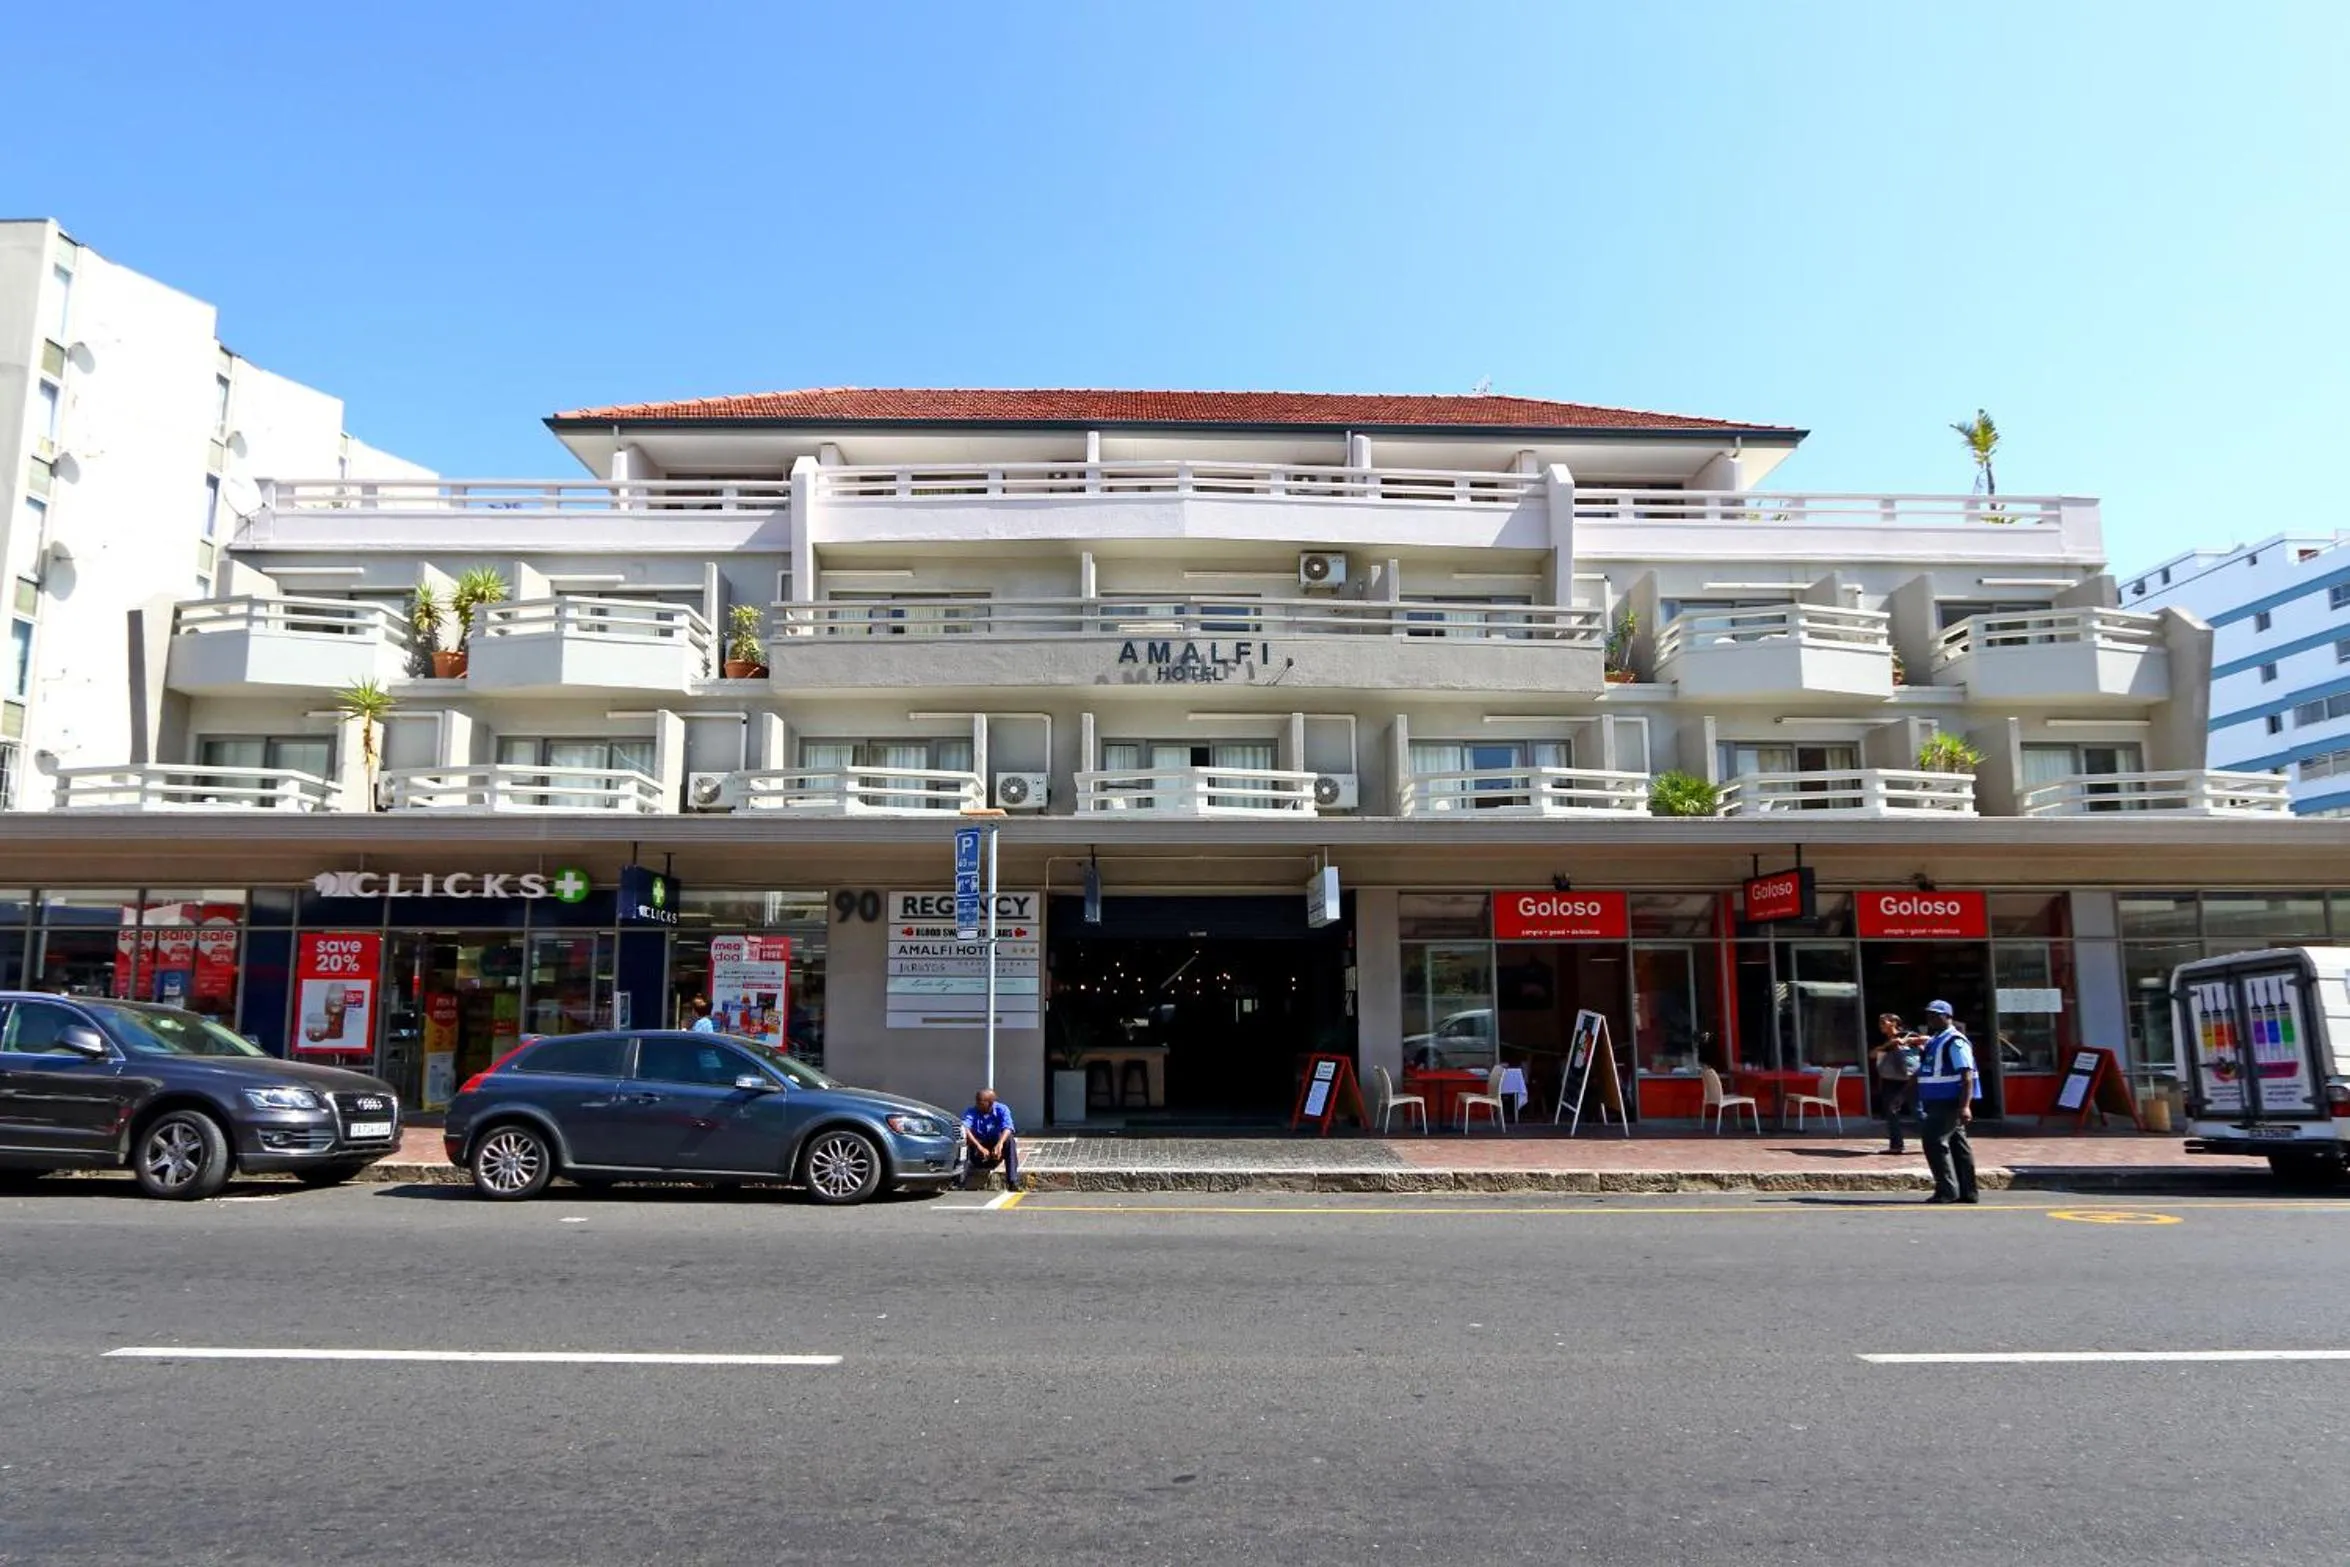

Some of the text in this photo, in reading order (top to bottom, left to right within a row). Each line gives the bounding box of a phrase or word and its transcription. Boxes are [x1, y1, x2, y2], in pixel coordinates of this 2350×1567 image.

[1119, 641, 1268, 664] AMALFI
[1157, 666, 1224, 681] HOTEL
[961, 837, 973, 854] P
[353, 872, 547, 898] CLICKS
[1752, 882, 1792, 900] Goloso
[835, 891, 880, 922] 90
[903, 896, 1030, 915] REGNCY
[1518, 897, 1601, 916] Goloso
[1880, 896, 1960, 915] Goloso
[644, 906, 677, 923] CLICKS
[200, 930, 234, 941] sale
[316, 940, 361, 953] save
[899, 945, 1001, 955] AMALFI HOTL
[316, 954, 360, 971] 20%
